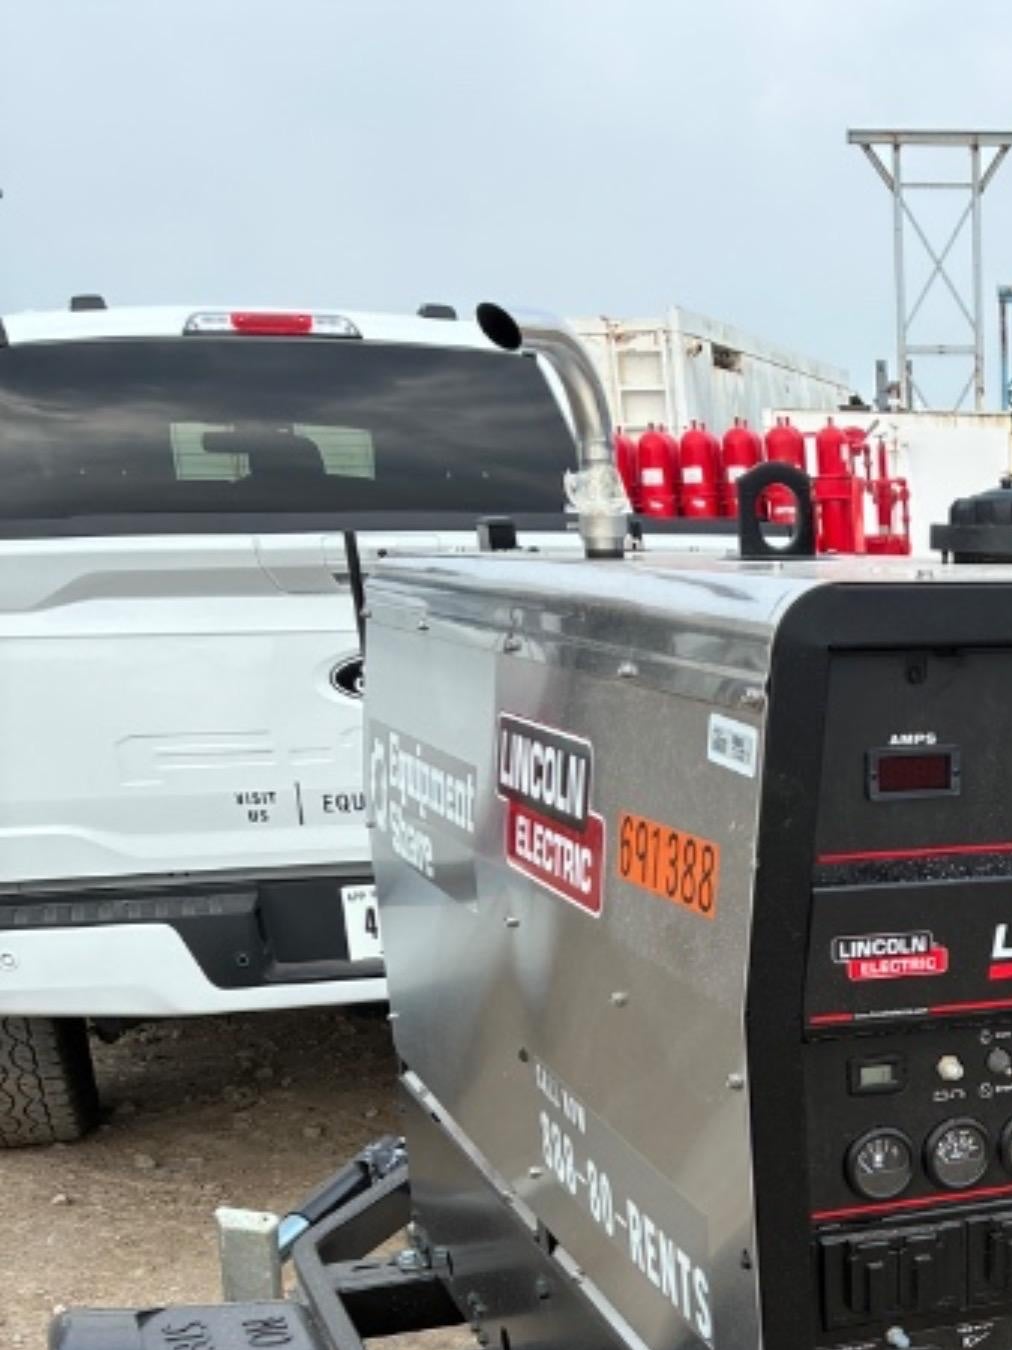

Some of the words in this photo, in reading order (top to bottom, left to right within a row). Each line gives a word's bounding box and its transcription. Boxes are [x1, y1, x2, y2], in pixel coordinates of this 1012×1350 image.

[889, 731, 937, 746] AMPS
[500, 729, 587, 820] LINCOLN
[234, 791, 277, 805] VISIT
[247, 809, 270, 823] US
[515, 814, 593, 894] ELECTRIC
[619, 814, 715, 913] 691388
[838, 935, 929, 959] LINCOLN
[859, 956, 937, 975] ELECTRIC
